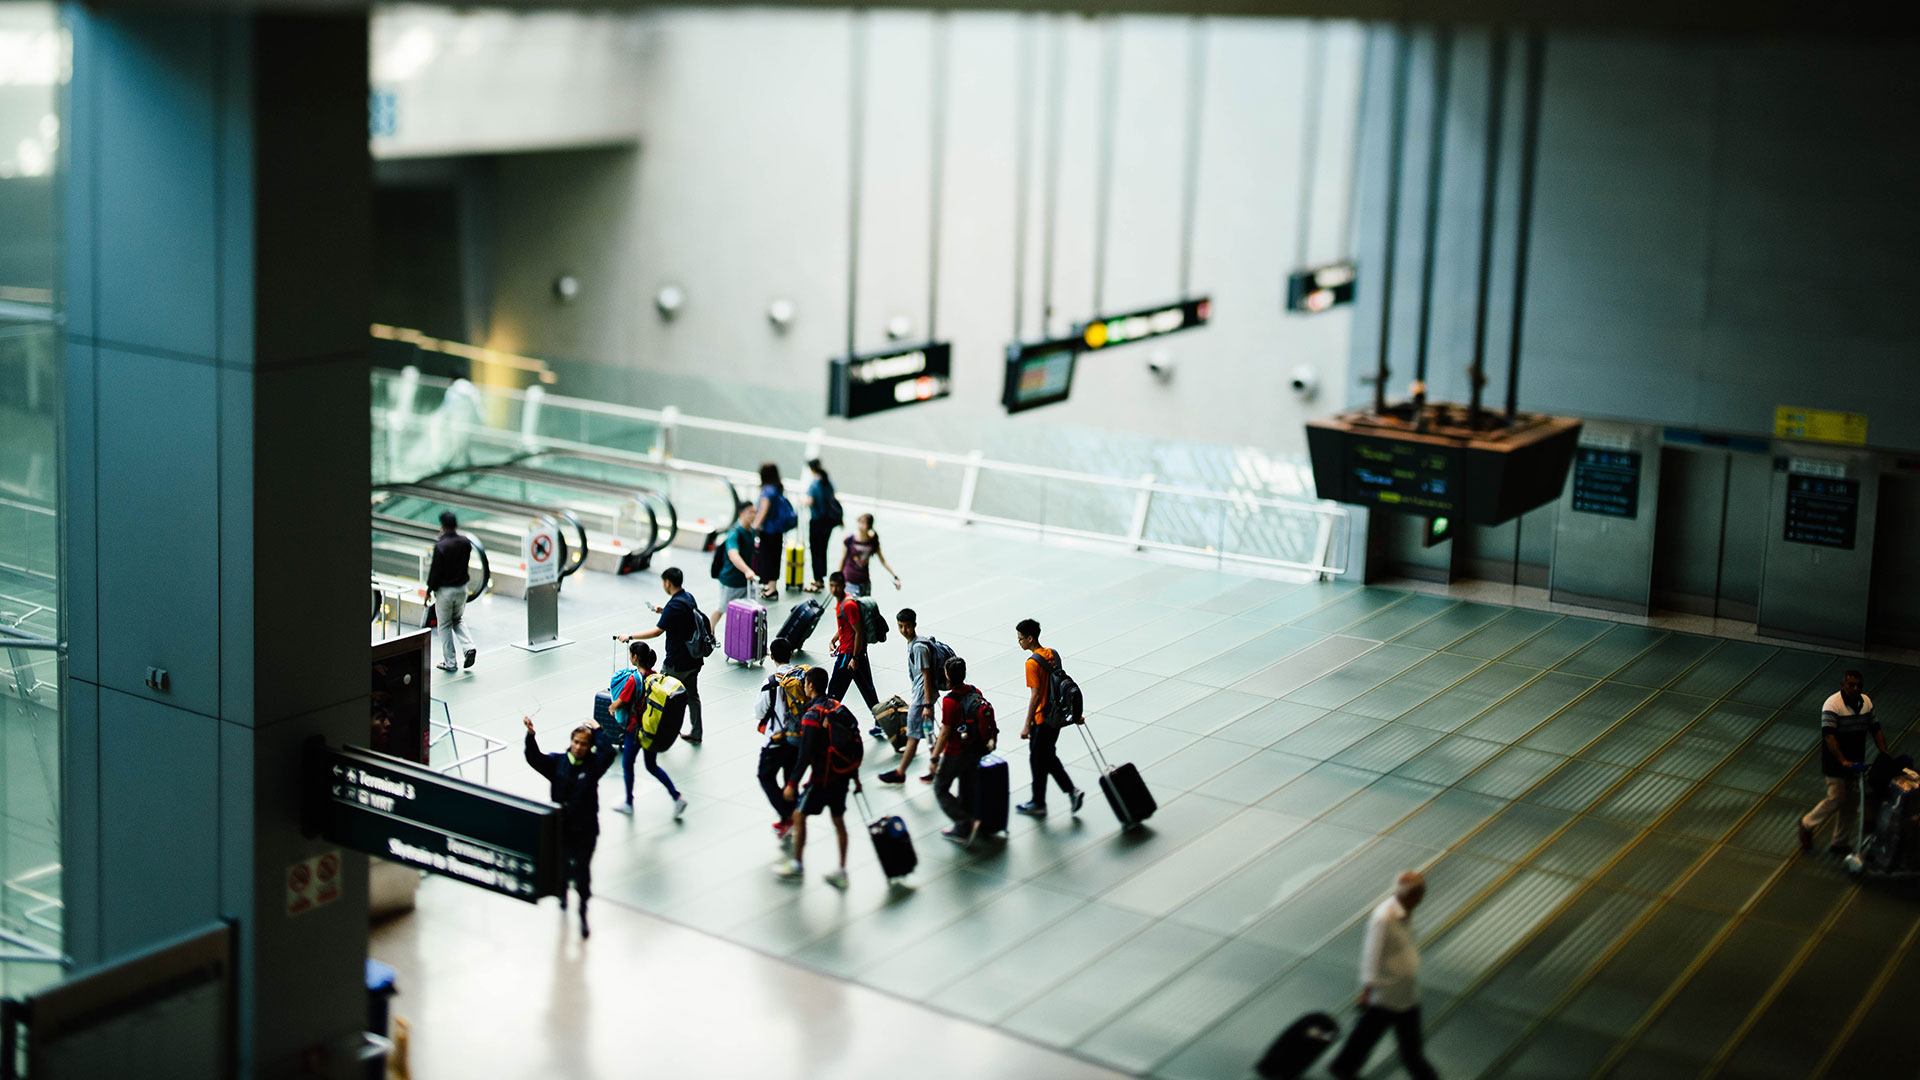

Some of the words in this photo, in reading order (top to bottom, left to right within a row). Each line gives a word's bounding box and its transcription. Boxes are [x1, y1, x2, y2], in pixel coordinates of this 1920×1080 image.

[359, 770, 405, 797] Terminal
[404, 784, 416, 800] 3
[370, 793, 396, 813] MRT
[388, 838, 433, 866] Skytrain
[432, 853, 448, 870] to
[447, 856, 496, 886] Terminal
[447, 836, 495, 865] Terminal
